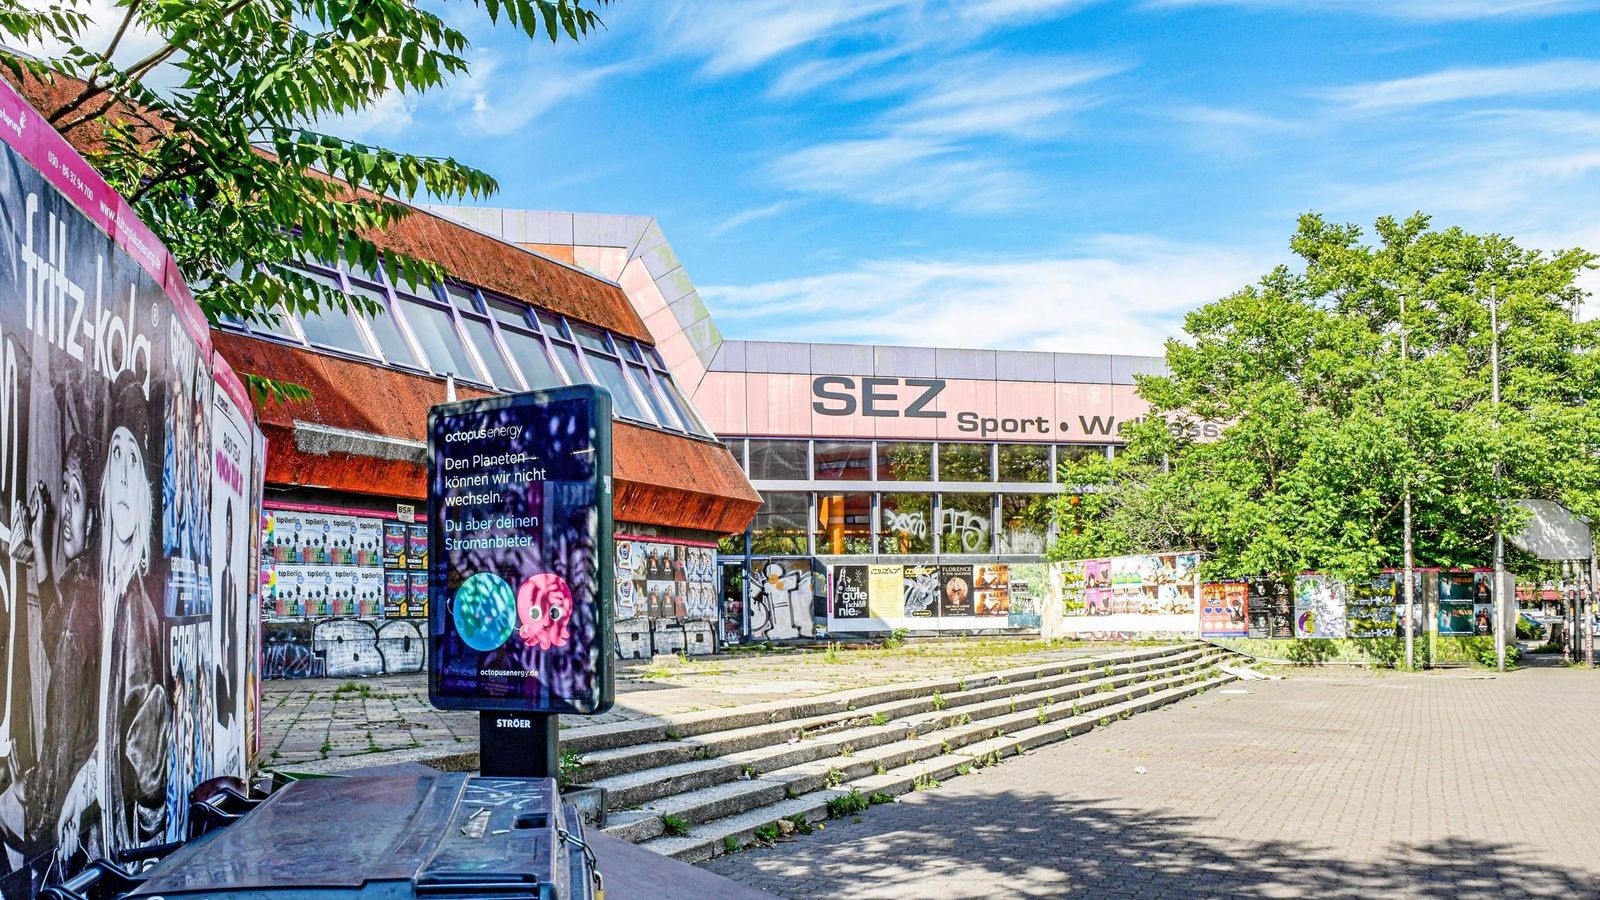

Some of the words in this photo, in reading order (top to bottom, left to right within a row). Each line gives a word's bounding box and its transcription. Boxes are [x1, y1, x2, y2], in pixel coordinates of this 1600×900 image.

[812, 375, 947, 419] SEZ
[957, 412, 1050, 437] Sport
[445, 457, 470, 471] Den
[472, 452, 526, 467] Planeten
[445, 473, 488, 489] können
[492, 472, 511, 485] wir
[514, 468, 547, 482] nicht
[445, 490, 503, 507] wechseln.
[398, 505, 413, 514] BSR
[445, 519, 462, 532] Du
[465, 517, 493, 532] aber
[496, 515, 539, 528] deinen
[445, 535, 535, 551] Stromanbieter.
[842, 587, 868, 603] gute
[1370, 595, 1394, 605] HKW
[1371, 628, 1395, 637] HKW
[480, 669, 539, 678] octopusenergy.de
[496, 718, 531, 729] STRÖER
